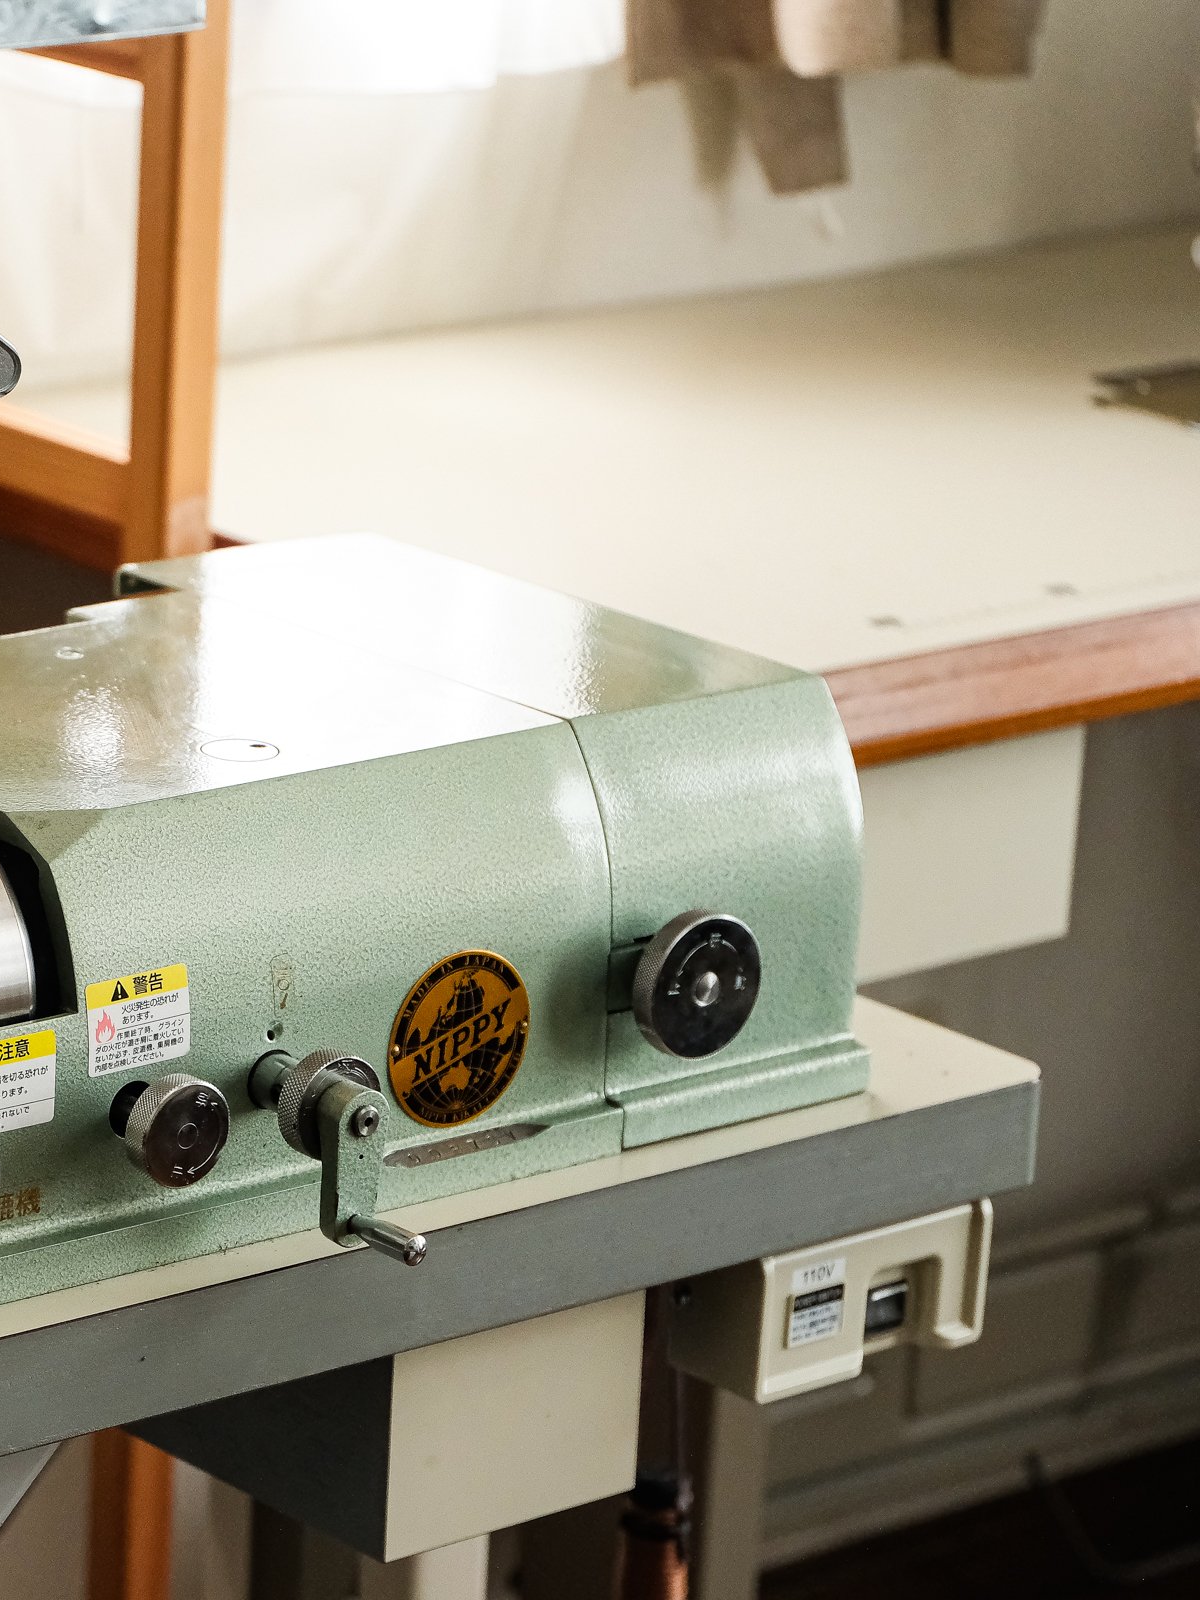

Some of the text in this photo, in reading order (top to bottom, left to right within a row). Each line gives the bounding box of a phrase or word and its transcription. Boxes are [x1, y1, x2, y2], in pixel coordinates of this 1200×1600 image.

[132, 972, 163, 995] 警告
[403, 956, 504, 1019] MADE IN JAPAN
[122, 992, 179, 1014] 火災発生の恐れが
[122, 1011, 154, 1025] あります。
[412, 998, 512, 1083] NIPPY
[95, 1053, 165, 1073] 内部を点検してください。
[803, 1263, 836, 1285] 110V
